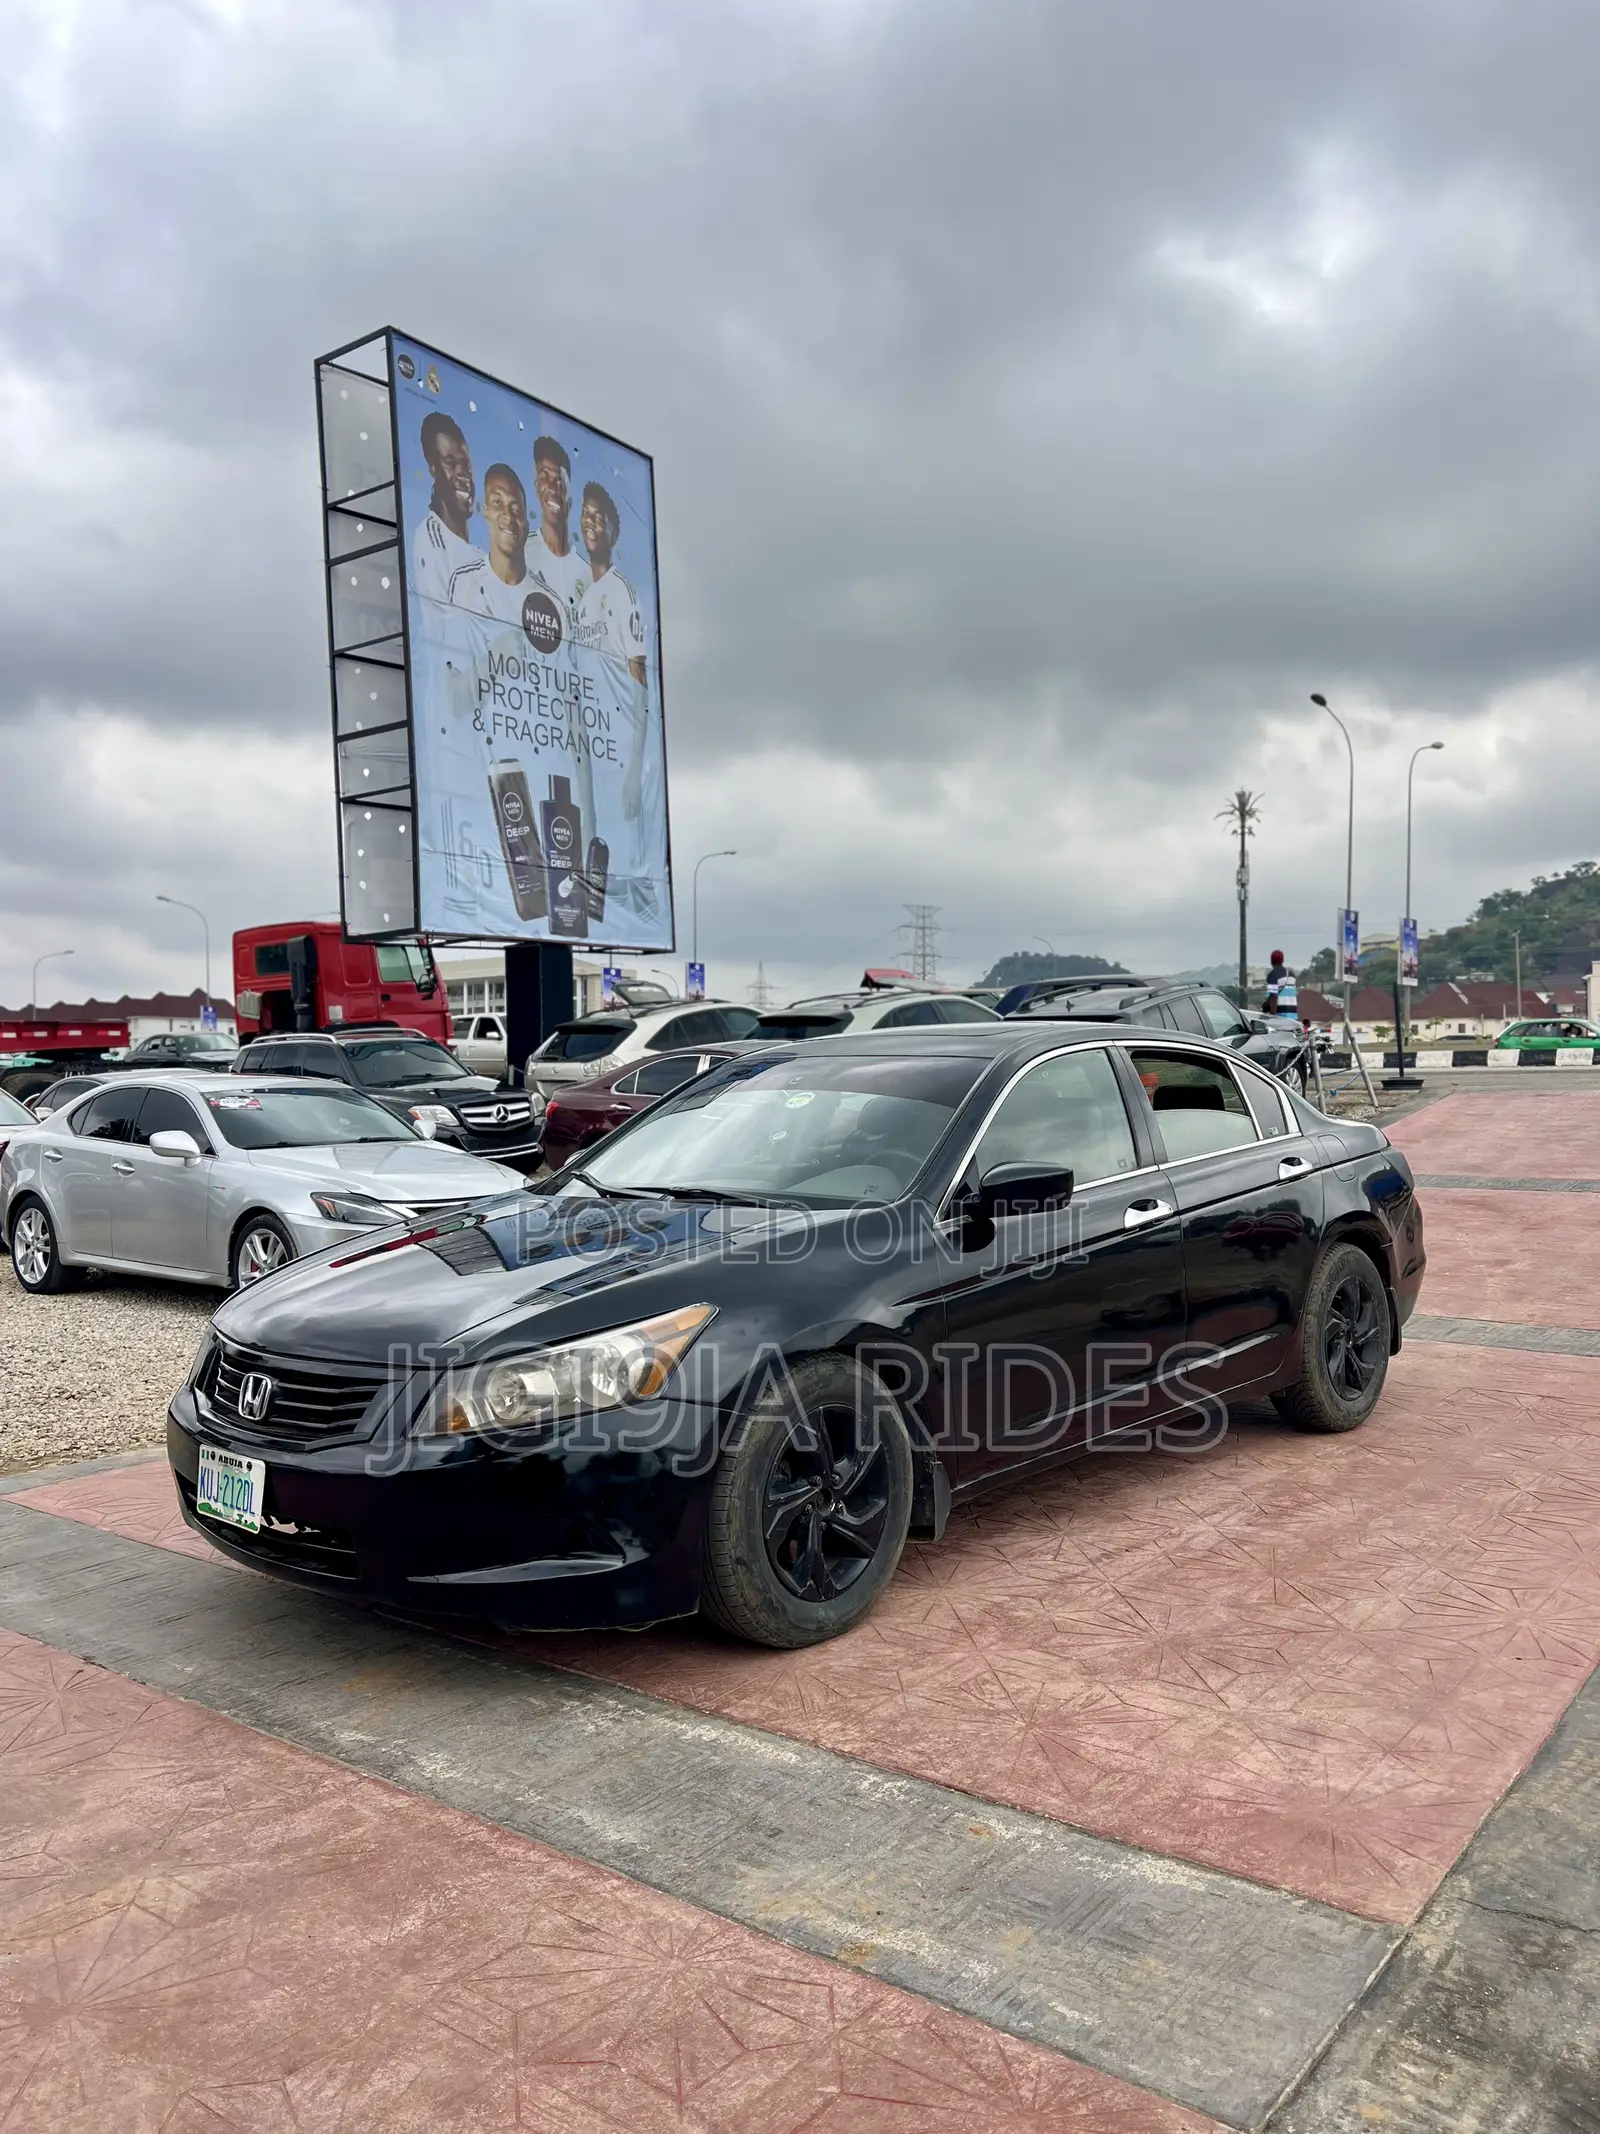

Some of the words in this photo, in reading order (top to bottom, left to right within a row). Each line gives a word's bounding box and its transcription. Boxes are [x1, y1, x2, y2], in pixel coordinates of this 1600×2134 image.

[525, 608, 559, 630] NIVEA
[530, 624, 556, 642] MEN
[487, 649, 600, 705] MOISTURE,
[478, 677, 611, 732] PROTECTION
[472, 707, 486, 733] &
[506, 826, 530, 838] DEEP
[553, 827, 571, 836] NIVEA
[550, 859, 573, 868] DEEP
[218, 1454, 243, 1469] ABUJA
[199, 1465, 256, 1515] KUJ-212DL
